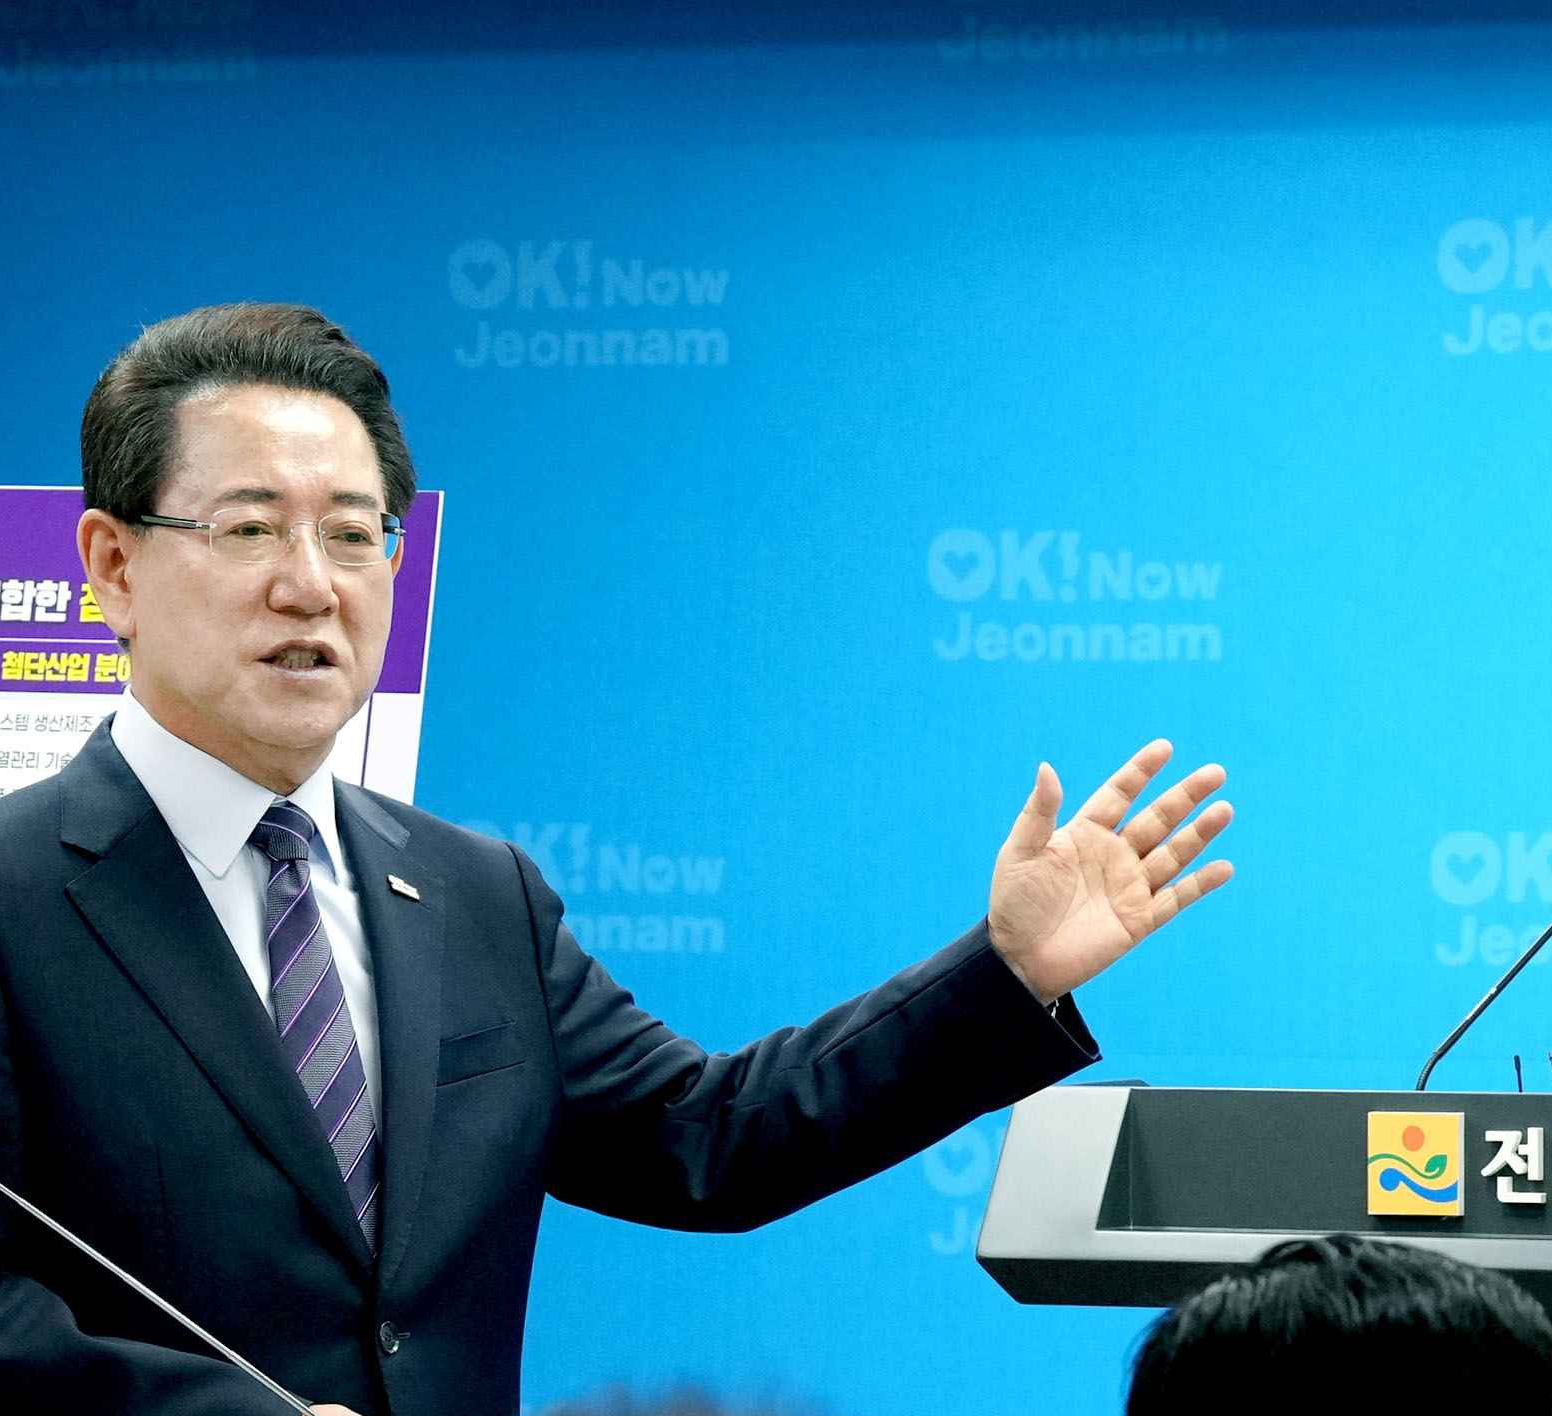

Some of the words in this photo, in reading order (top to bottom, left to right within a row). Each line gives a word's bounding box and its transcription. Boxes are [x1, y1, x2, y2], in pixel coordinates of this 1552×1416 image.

[933, 611, 1222, 662] Jeonnam
[1, 650, 90, 681] 첨단산업
[34, 715, 92, 733] 생산제조
